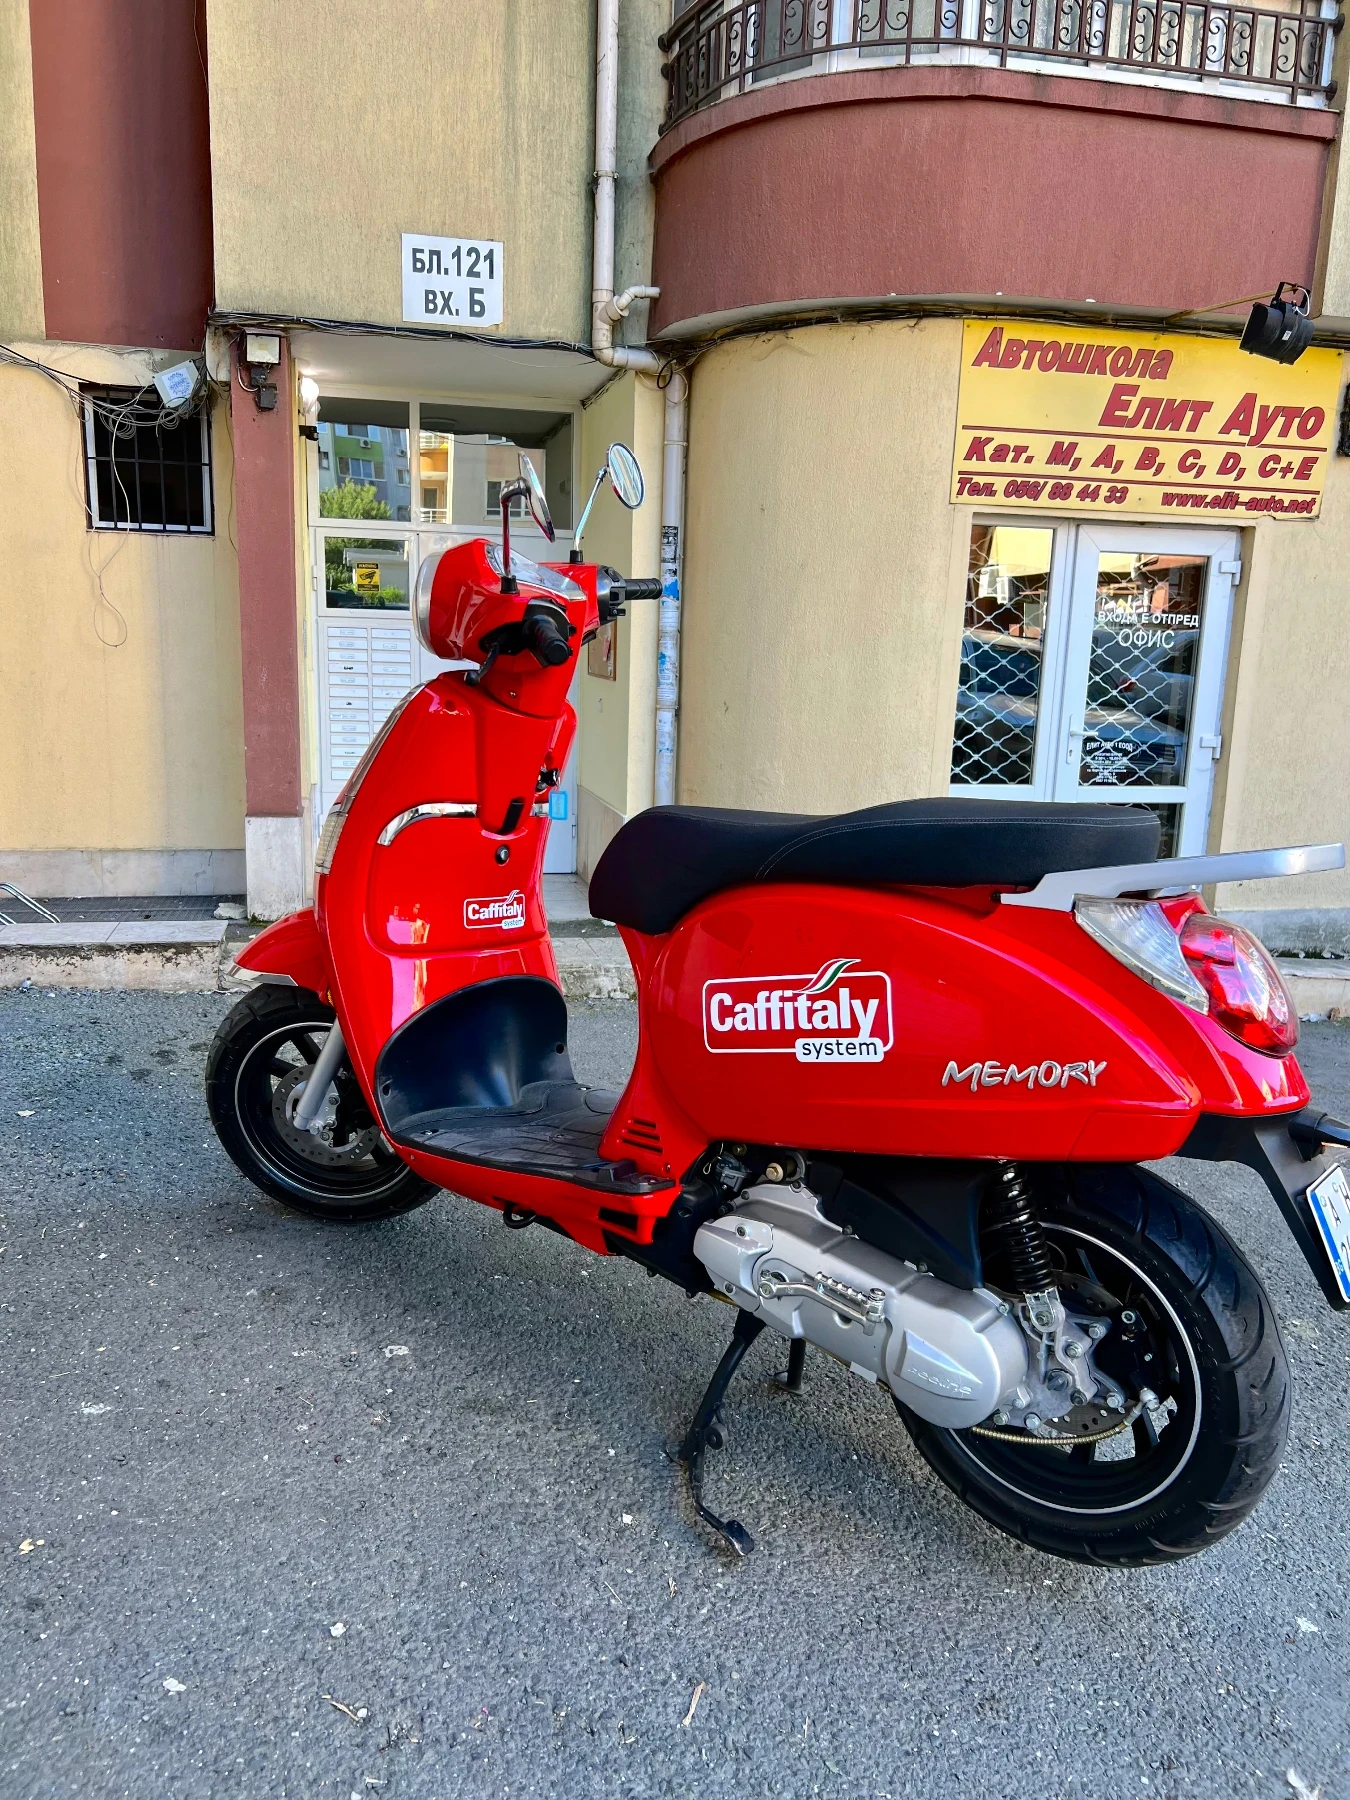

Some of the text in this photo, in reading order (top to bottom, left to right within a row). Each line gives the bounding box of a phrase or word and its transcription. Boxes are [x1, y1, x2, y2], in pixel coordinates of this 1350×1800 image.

[411, 245, 494, 280] БЛ.121
[424, 286, 486, 319] ВХ. Б
[971, 326, 1174, 380] Автошкола
[1098, 382, 1326, 447] Елит Ауто
[963, 436, 1035, 464] Кат.
[956, 477, 1129, 504] Тел. 056/ 88 44 33
[1161, 491, 1317, 514] www.elit-auto.net
[1098, 611, 1199, 628] ВХОДА Е ОТПРЕД
[1118, 628, 1175, 649] ОФИС
[467, 901, 523, 920] Caffitaly
[503, 919, 523, 928] system
[710, 987, 879, 1039] Caffitaly
[801, 1039, 878, 1059] system
[941, 1060, 1108, 1092] MEMORY
